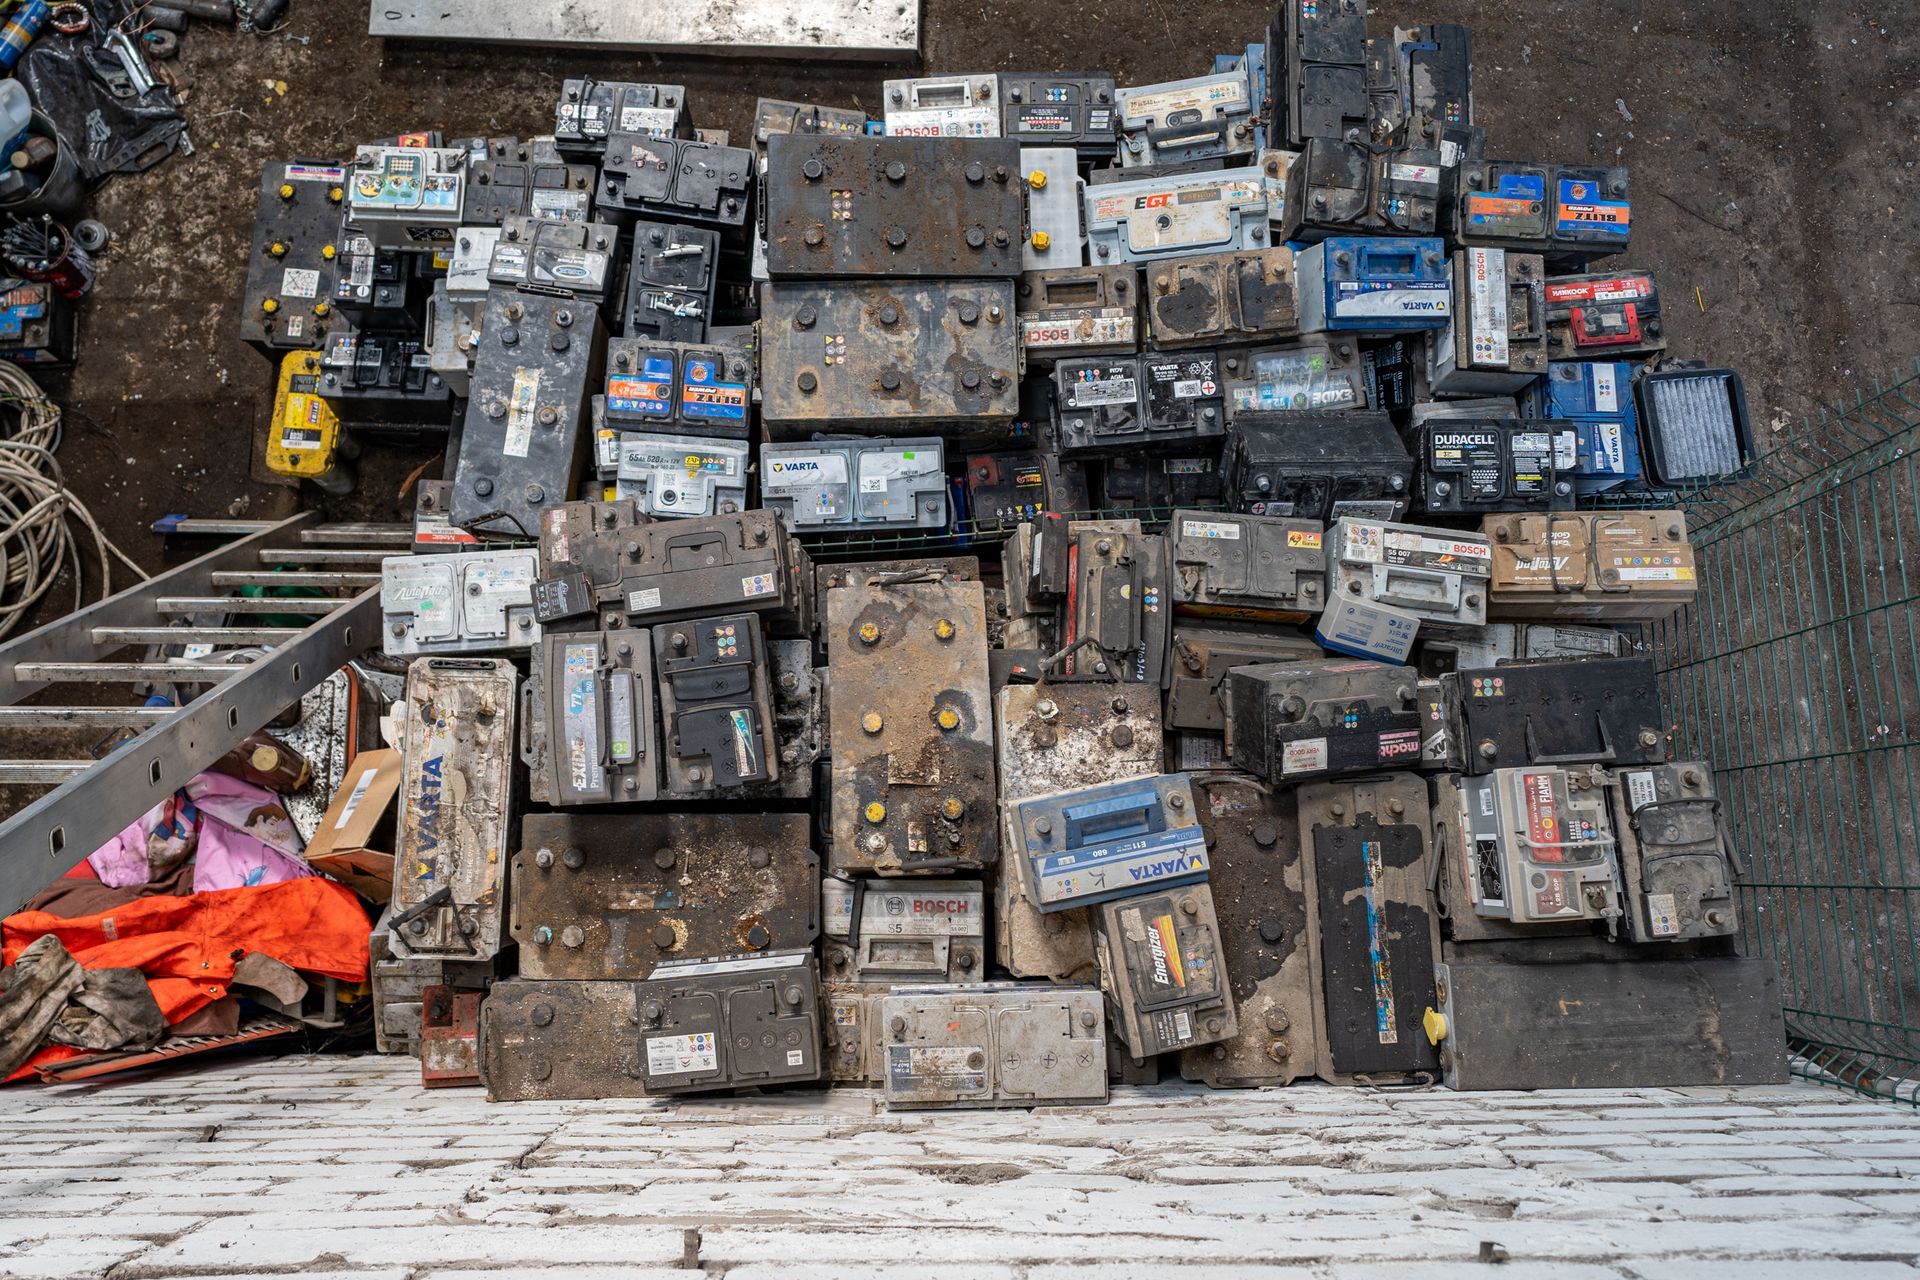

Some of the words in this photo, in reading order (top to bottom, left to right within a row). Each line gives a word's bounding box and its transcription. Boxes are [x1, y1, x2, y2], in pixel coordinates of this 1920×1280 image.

[1134, 193, 1173, 209] EGT
[1576, 212, 1617, 222] BLITZ
[1477, 252, 1487, 281] BOSCH
[1552, 287, 1589, 297] HANKOOK
[1402, 302, 1435, 310] VARTA
[1023, 329, 1070, 343] BOSCH
[696, 394, 742, 405] BLITZ
[1312, 390, 1354, 404] EXIDE
[1435, 434, 1495, 445] DURACELL
[1610, 436, 1619, 464] VARTA
[784, 462, 819, 472] VARTA
[1398, 550, 1411, 558] 007
[1453, 543, 1486, 556] BOSCH
[1373, 641, 1404, 656] Ultracell
[571, 694, 582, 709] 77
[1379, 741, 1419, 758] macht
[570, 738, 587, 791] EXIDE
[590, 748, 600, 788] Premium
[1537, 775, 1550, 803] FIAMM
[417, 756, 443, 854] VARTA
[1132, 840, 1147, 849] E11
[1092, 848, 1108, 857] 680
[1129, 859, 1189, 881] VARTA
[913, 899, 969, 914] BOSCH
[888, 923, 903, 934] S5
[1147, 925, 1170, 985] Energizer
